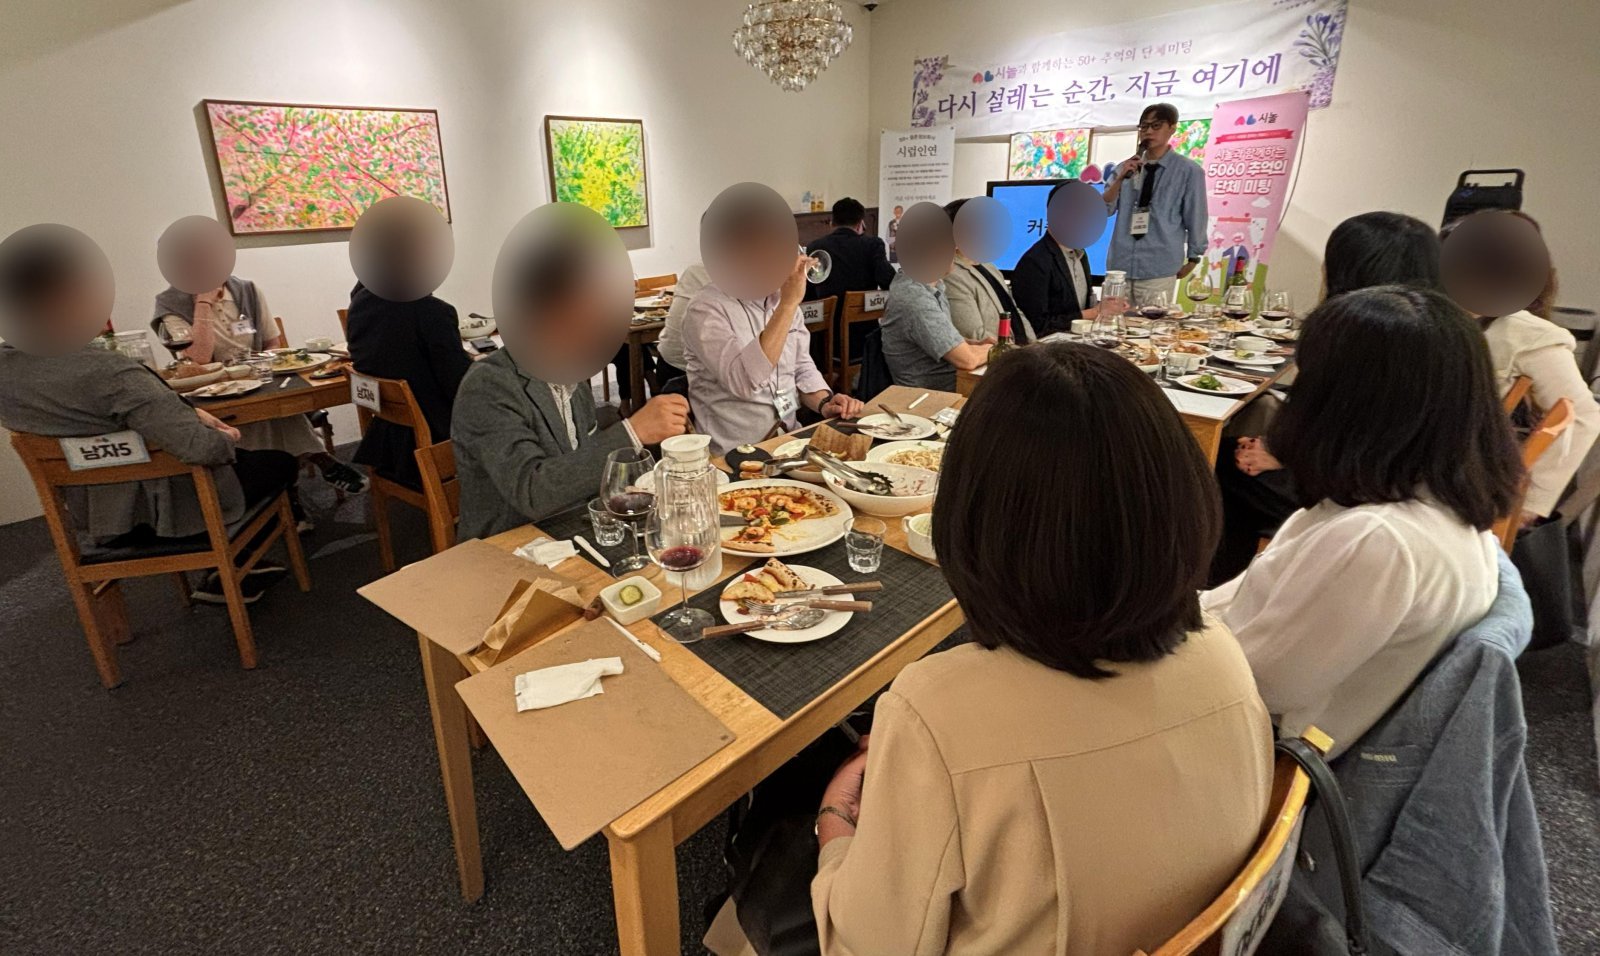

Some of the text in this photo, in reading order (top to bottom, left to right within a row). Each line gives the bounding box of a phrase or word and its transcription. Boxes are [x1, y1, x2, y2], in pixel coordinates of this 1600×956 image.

[1032, 58, 1074, 74] 함께하는
[1078, 55, 1096, 66] 50+
[1101, 48, 1136, 64] 추억의
[938, 52, 1282, 120] 다시 설레는 순간, 지금 여기에
[1258, 112, 1278, 124] 시놀
[1207, 159, 1288, 178] 5060 추억의
[1214, 177, 1272, 195] 단체 미팅
[1027, 217, 1049, 237] 커
[79, 442, 132, 461] 남자5
